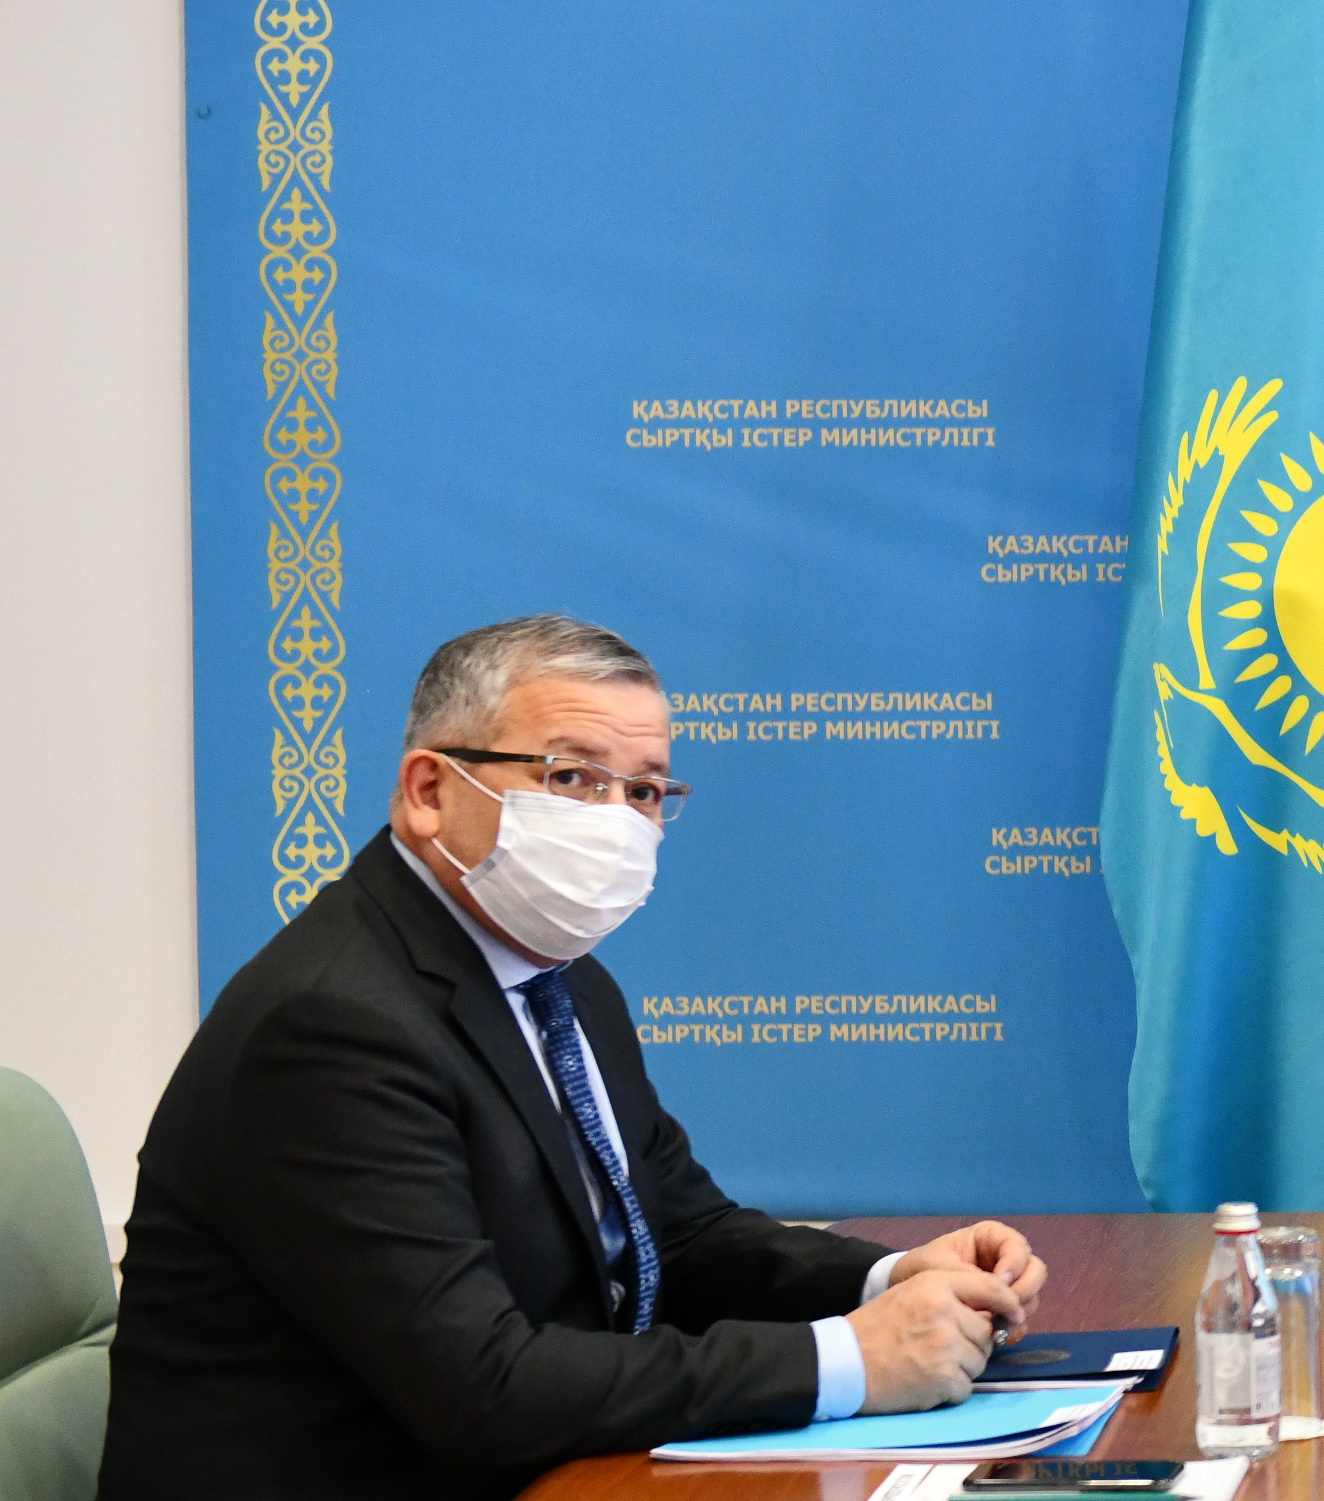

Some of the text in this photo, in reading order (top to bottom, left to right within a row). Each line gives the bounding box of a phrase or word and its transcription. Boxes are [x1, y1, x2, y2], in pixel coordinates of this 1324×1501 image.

[632, 398, 989, 423] ҚАЗАҚСТАН РЕСПУБЛИКАСЫ
[625, 427, 735, 451] СЫРТҚЫ
[980, 562, 1089, 586] СЫРТҚЫ
[671, 691, 994, 716] ЗАҚСТАН РЕСПУБЛИКАСЫ
[670, 720, 740, 745] РТҚЫ
[991, 826, 1100, 850] ҚАЗАҚСТ
[984, 854, 1093, 878] СЫРТҚЫ
[642, 993, 998, 1019] ҚАЗАҚСТАН РЕСПУБЛИКАСЫ
[636, 1023, 744, 1048] СЫРТҚЫ
